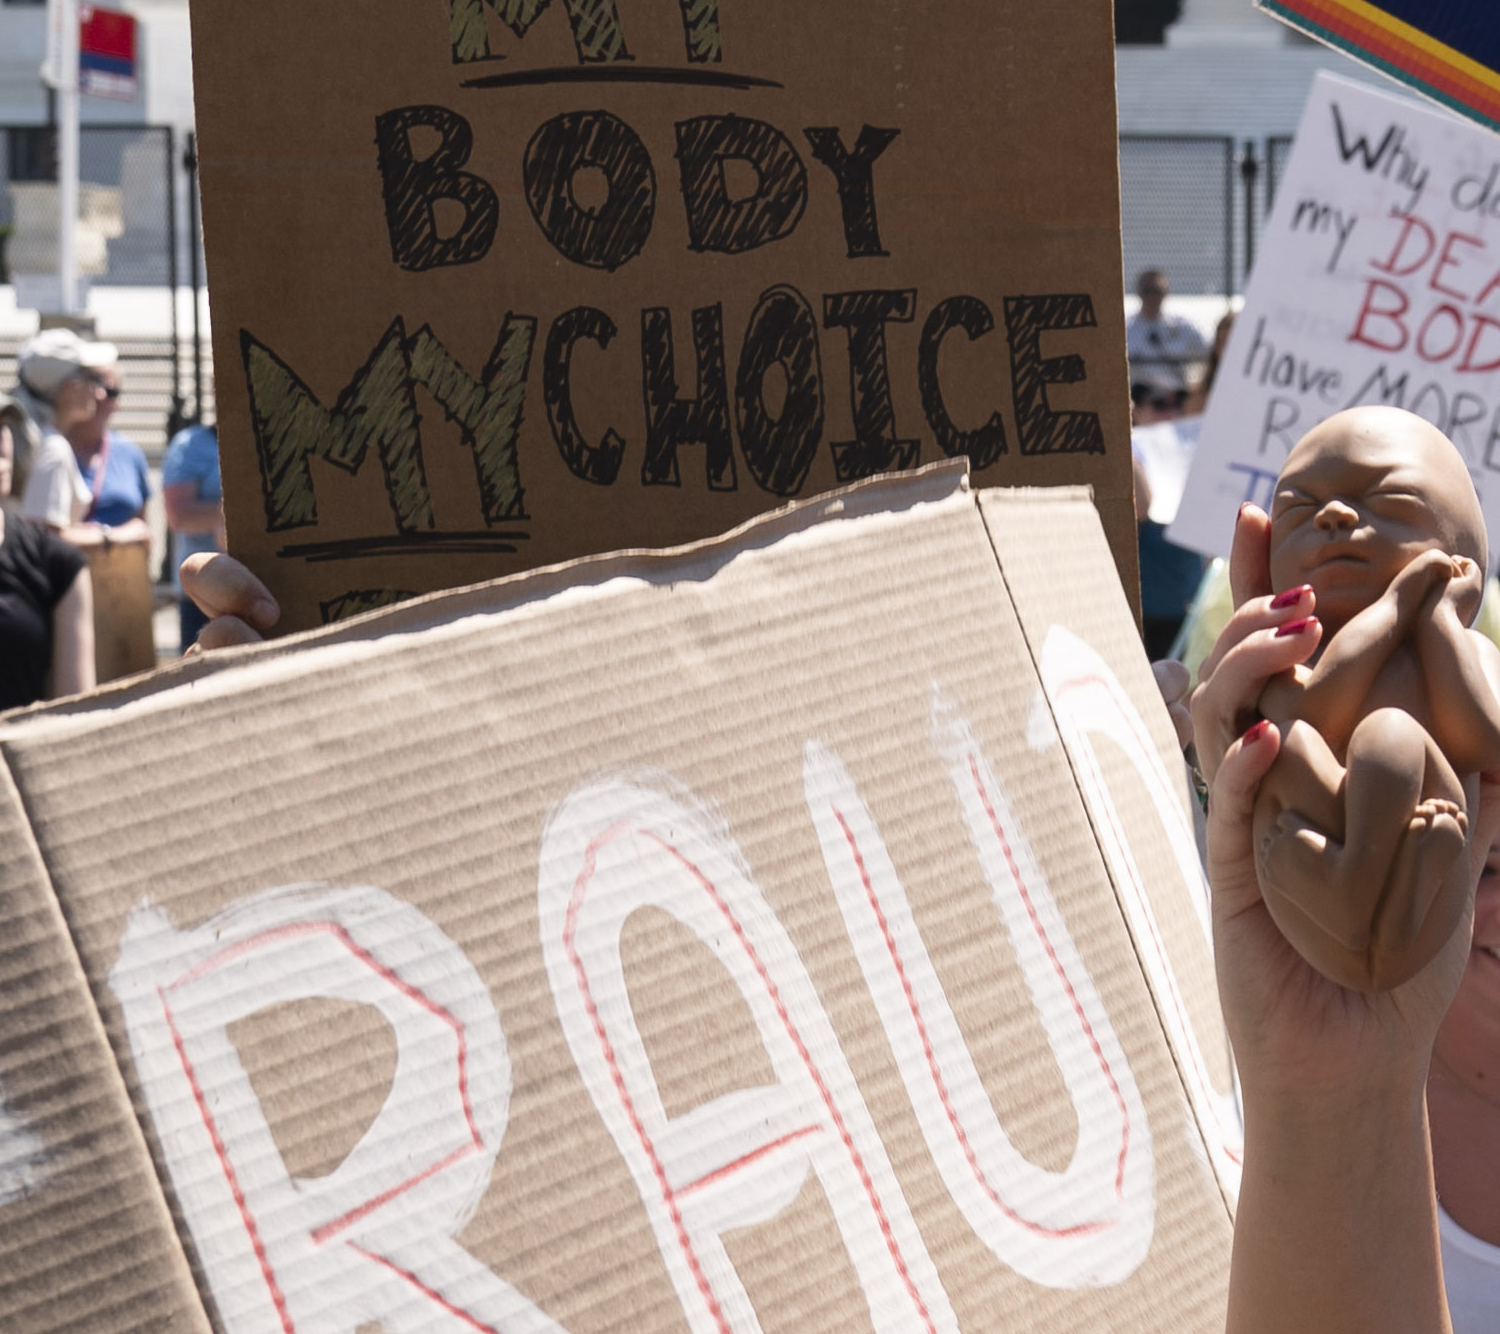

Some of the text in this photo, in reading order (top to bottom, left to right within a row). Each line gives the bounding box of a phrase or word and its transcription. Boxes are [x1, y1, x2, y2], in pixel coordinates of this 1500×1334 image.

[375, 104, 902, 272] BODY
[1330, 100, 1430, 216] Why
[1290, 197, 1359, 274] my
[239, 283, 1106, 535] MY CHOICE
[1242, 314, 1344, 399] have
